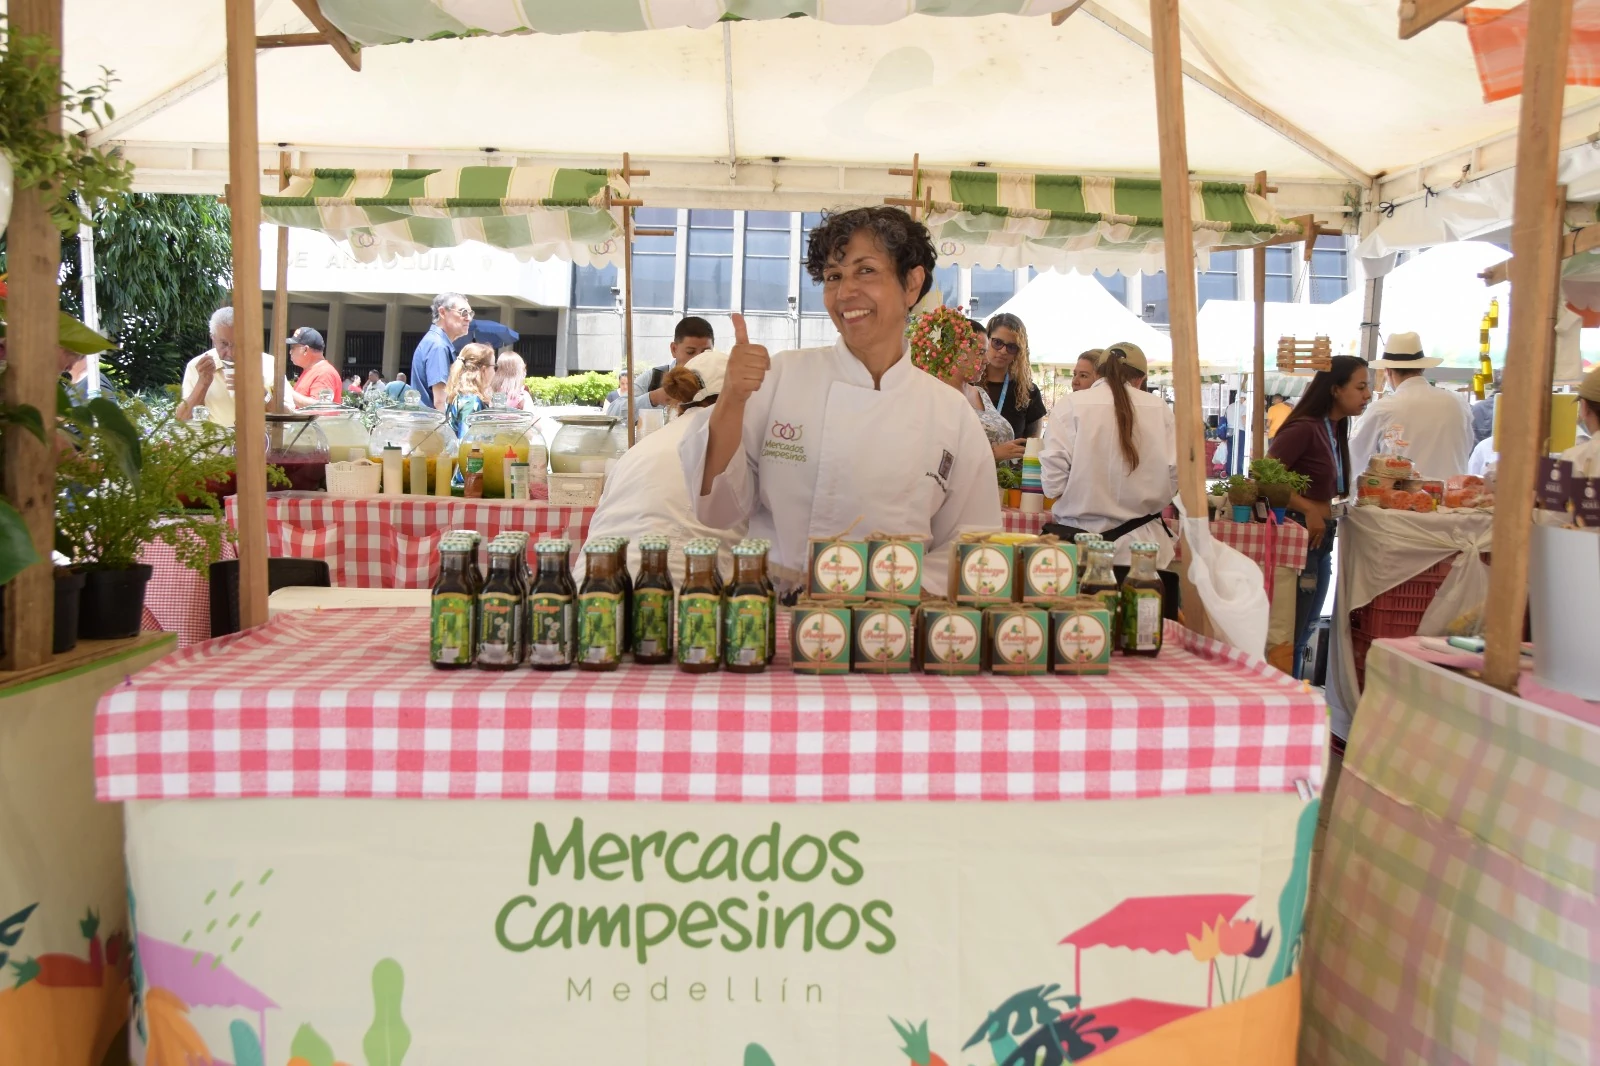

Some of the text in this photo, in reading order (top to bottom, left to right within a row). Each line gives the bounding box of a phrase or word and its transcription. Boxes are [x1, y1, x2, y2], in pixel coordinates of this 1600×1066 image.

[761, 449, 807, 463] Campesinos
[764, 440, 804, 454] Mercados
[528, 817, 864, 886] Mercados
[495, 891, 896, 965] Campesinos
[567, 976, 823, 1002] Medellín
